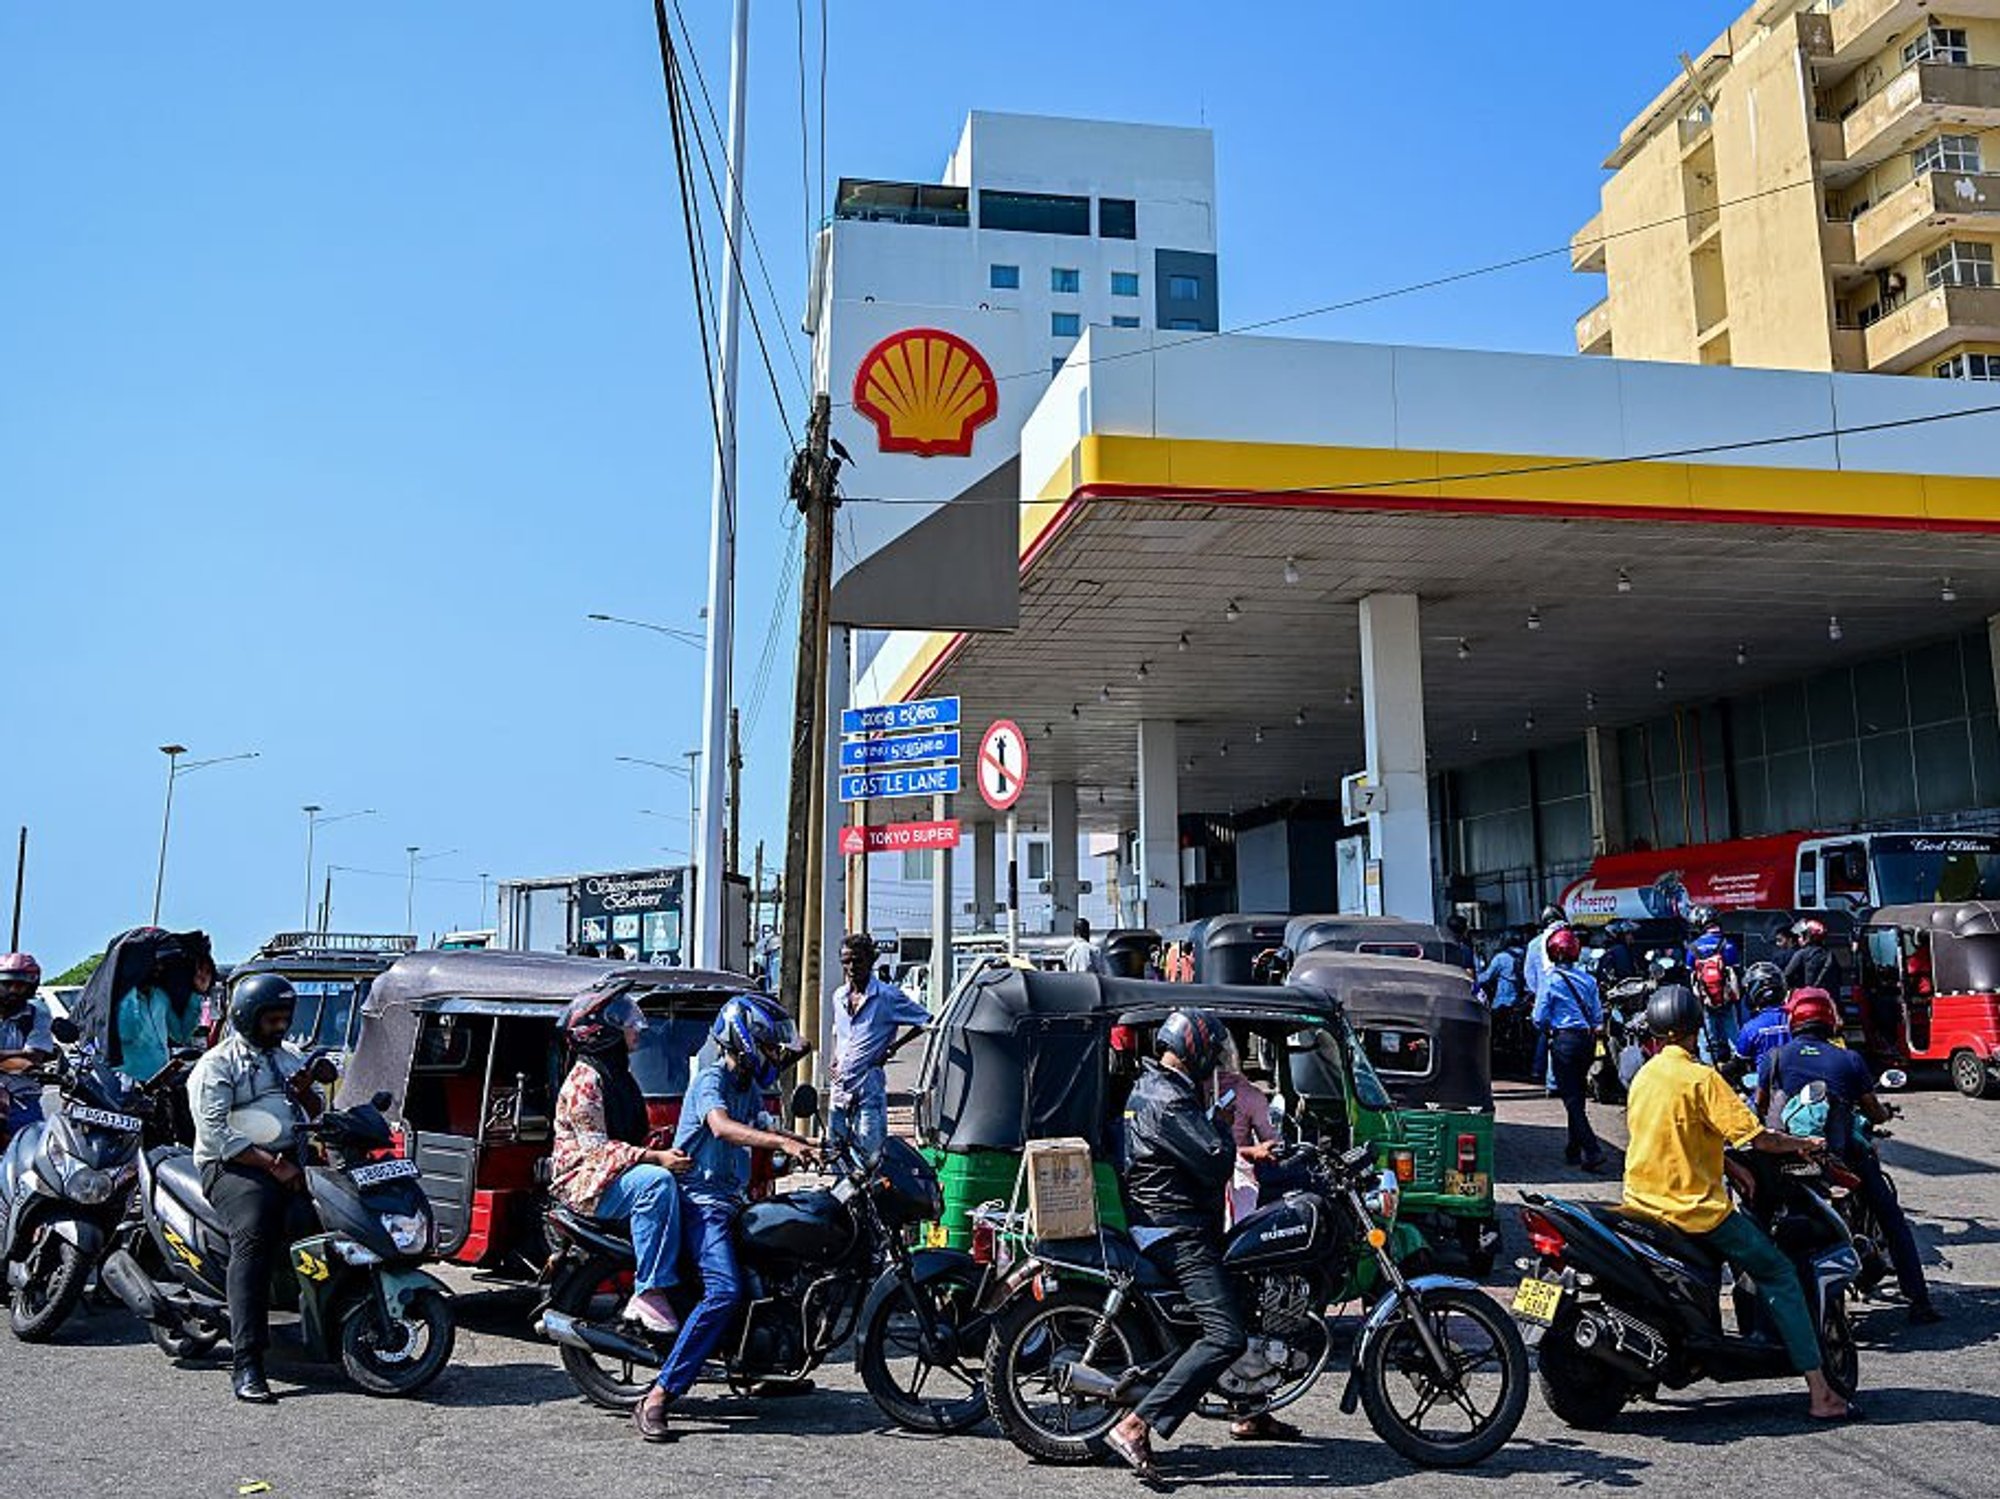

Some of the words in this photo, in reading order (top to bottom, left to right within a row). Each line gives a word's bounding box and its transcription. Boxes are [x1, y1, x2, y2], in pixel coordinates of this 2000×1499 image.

[849, 773, 904, 796] CASTLE
[908, 770, 948, 791] LANE
[1364, 793, 1374, 806] 7
[869, 832, 911, 846] TOKYO
[912, 827, 954, 843] SUPER
